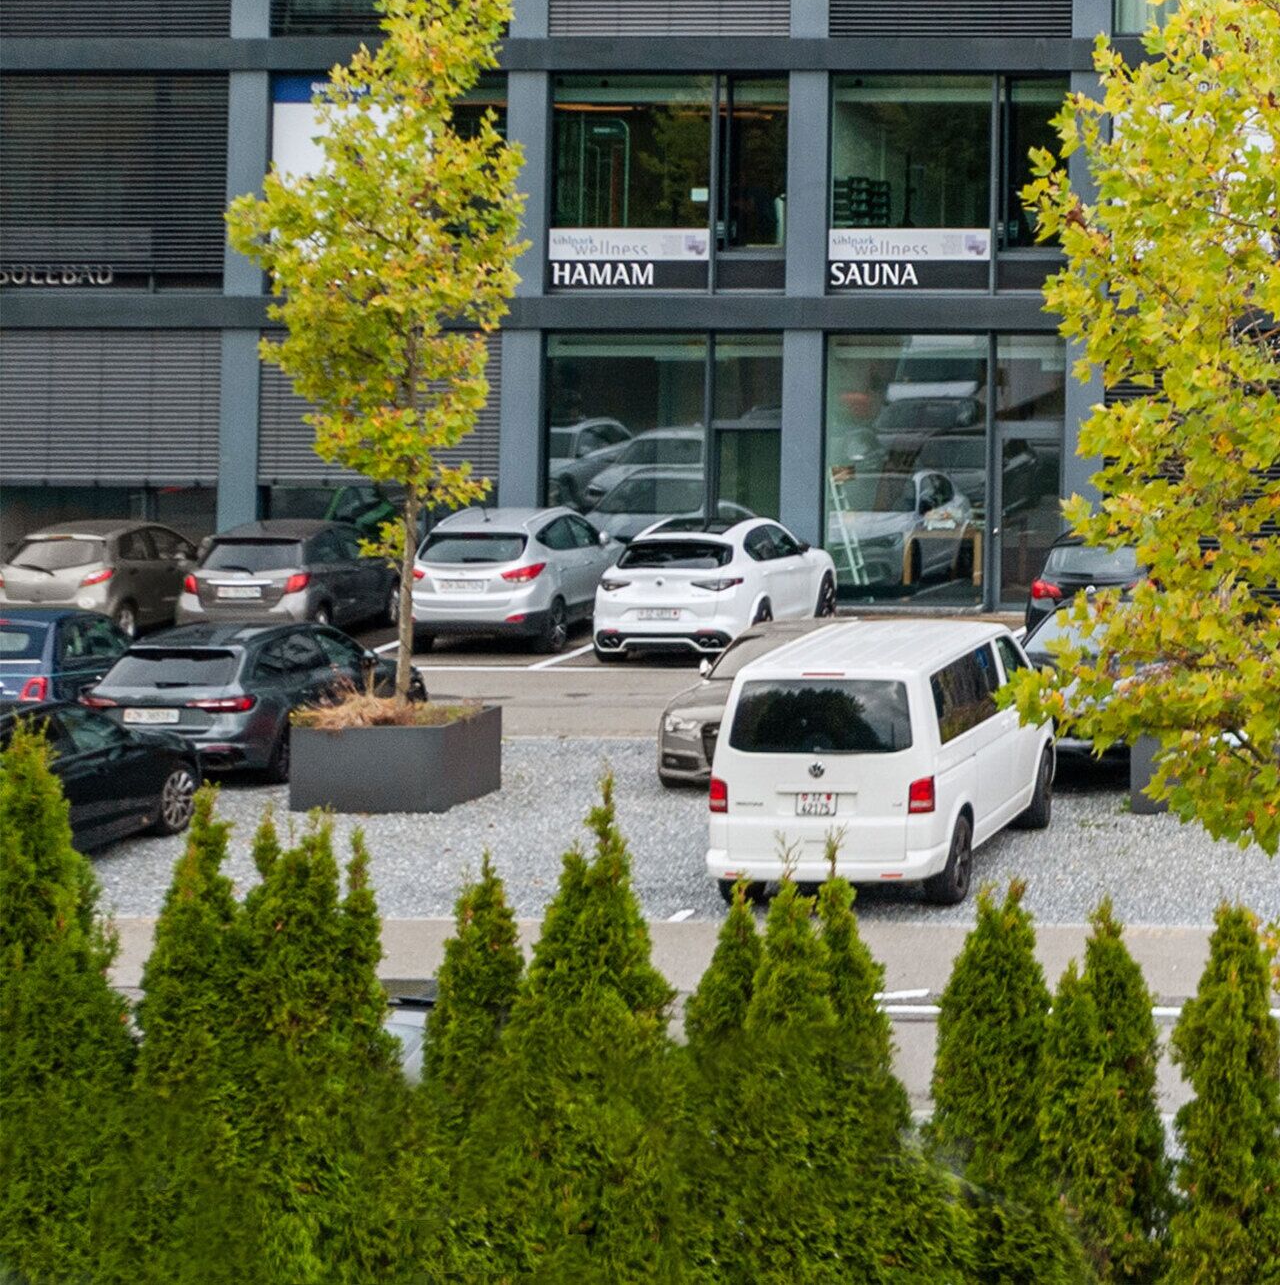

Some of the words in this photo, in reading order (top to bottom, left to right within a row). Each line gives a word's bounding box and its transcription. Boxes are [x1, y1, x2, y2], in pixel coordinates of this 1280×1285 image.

[574, 241, 649, 256] wellness
[854, 241, 929, 256] wellness
[552, 262, 655, 286] HAMAM
[830, 262, 919, 286] SAUNA
